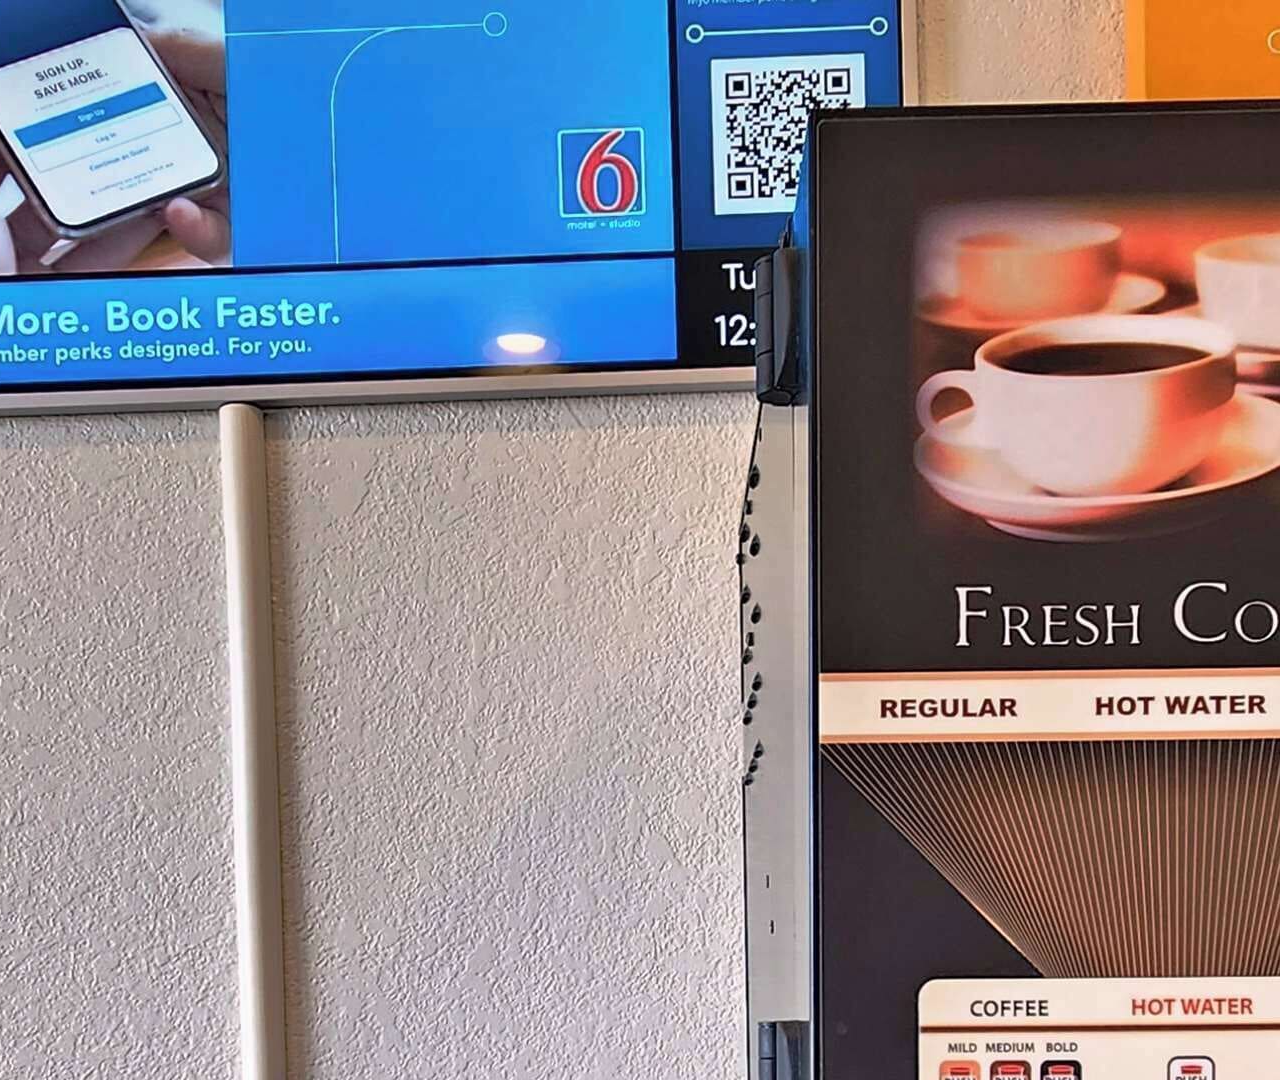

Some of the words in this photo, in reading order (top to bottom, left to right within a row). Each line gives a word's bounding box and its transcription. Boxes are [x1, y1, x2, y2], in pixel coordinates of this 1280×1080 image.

[35, 63, 67, 82] SIGN
[67, 57, 90, 74] UP.
[33, 80, 67, 100] SAVE
[69, 69, 108, 89] MORE.
[576, 127, 639, 215] 6
[721, 263, 757, 291] Tu
[105, 297, 201, 333] Book
[216, 297, 341, 329] Faster.
[54, 341, 113, 366] perks
[119, 336, 220, 363] designed.
[228, 336, 261, 356] For
[268, 338, 313, 359] you.
[880, 697, 1019, 719] REGULAR
[1095, 695, 1157, 717] HOT
[1165, 694, 1267, 716] WATER
[969, 999, 1049, 1018] COFFEE
[1130, 998, 1176, 1017] HOT
[1180, 997, 1254, 1017] WATER
[947, 1042, 978, 1054] MILD
[985, 1042, 1036, 1054] MEDIUM
[1045, 1042, 1079, 1053] BOLD
